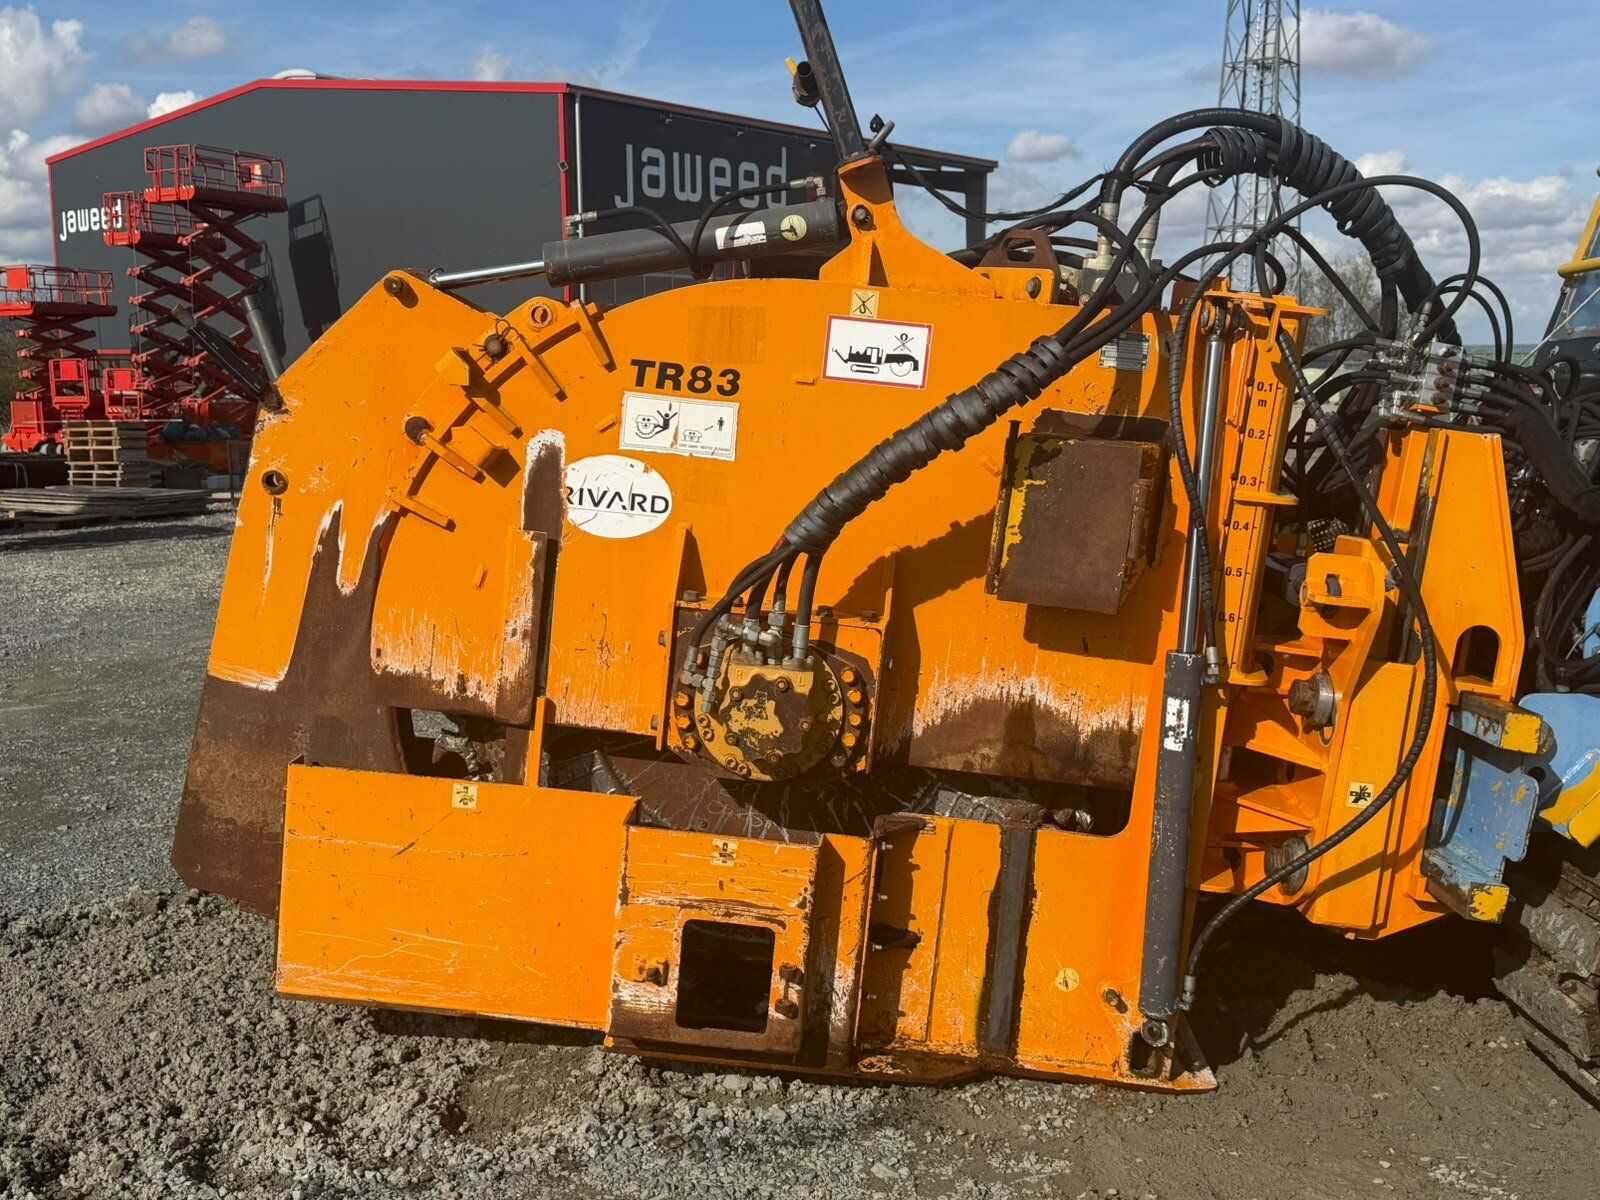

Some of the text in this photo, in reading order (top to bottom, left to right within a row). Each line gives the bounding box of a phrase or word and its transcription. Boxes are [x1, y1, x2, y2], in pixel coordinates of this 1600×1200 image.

[614, 143, 787, 209] jaweed
[630, 359, 741, 397] TR83
[1257, 381, 1273, 392] 0.1
[1257, 399, 1267, 407] m
[1247, 428, 1266, 439] 0.2
[1239, 475, 1257, 487] 0.3
[1232, 520, 1249, 531] 0.4
[1225, 566, 1242, 577] 0.5
[1218, 612, 1235, 622] 0.6
